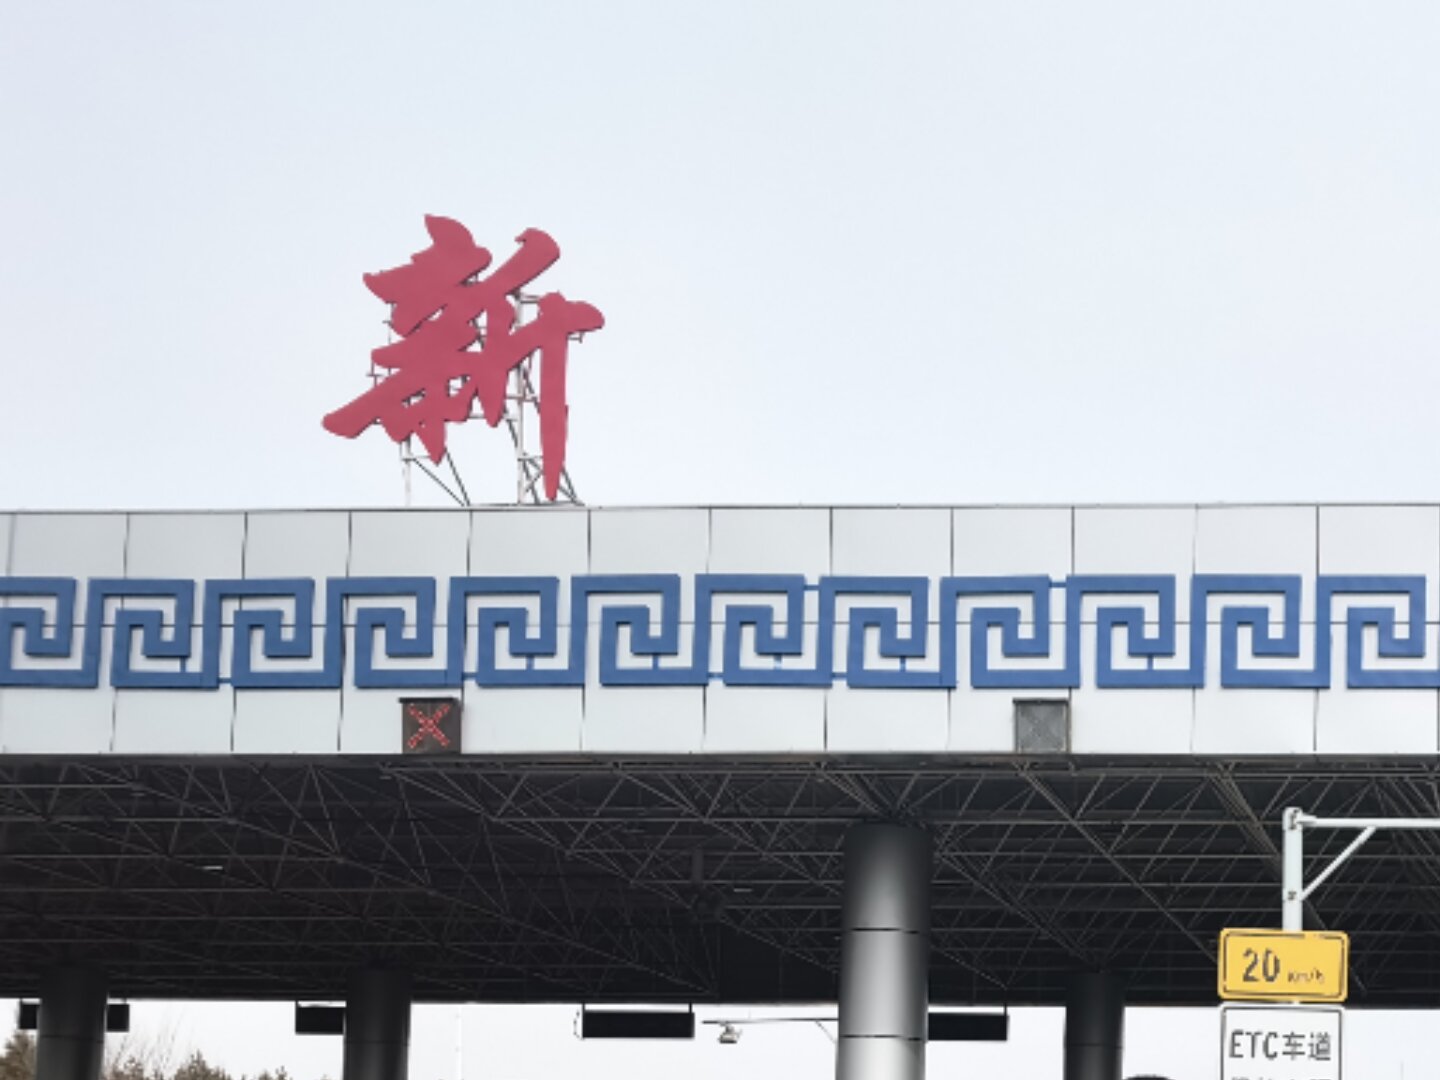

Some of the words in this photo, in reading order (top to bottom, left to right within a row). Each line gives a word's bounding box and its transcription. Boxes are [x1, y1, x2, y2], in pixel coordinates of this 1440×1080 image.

[321, 213, 605, 502] 新
[1242, 948, 1280, 982] 20
[1229, 1029, 1331, 1061] ETC车道
